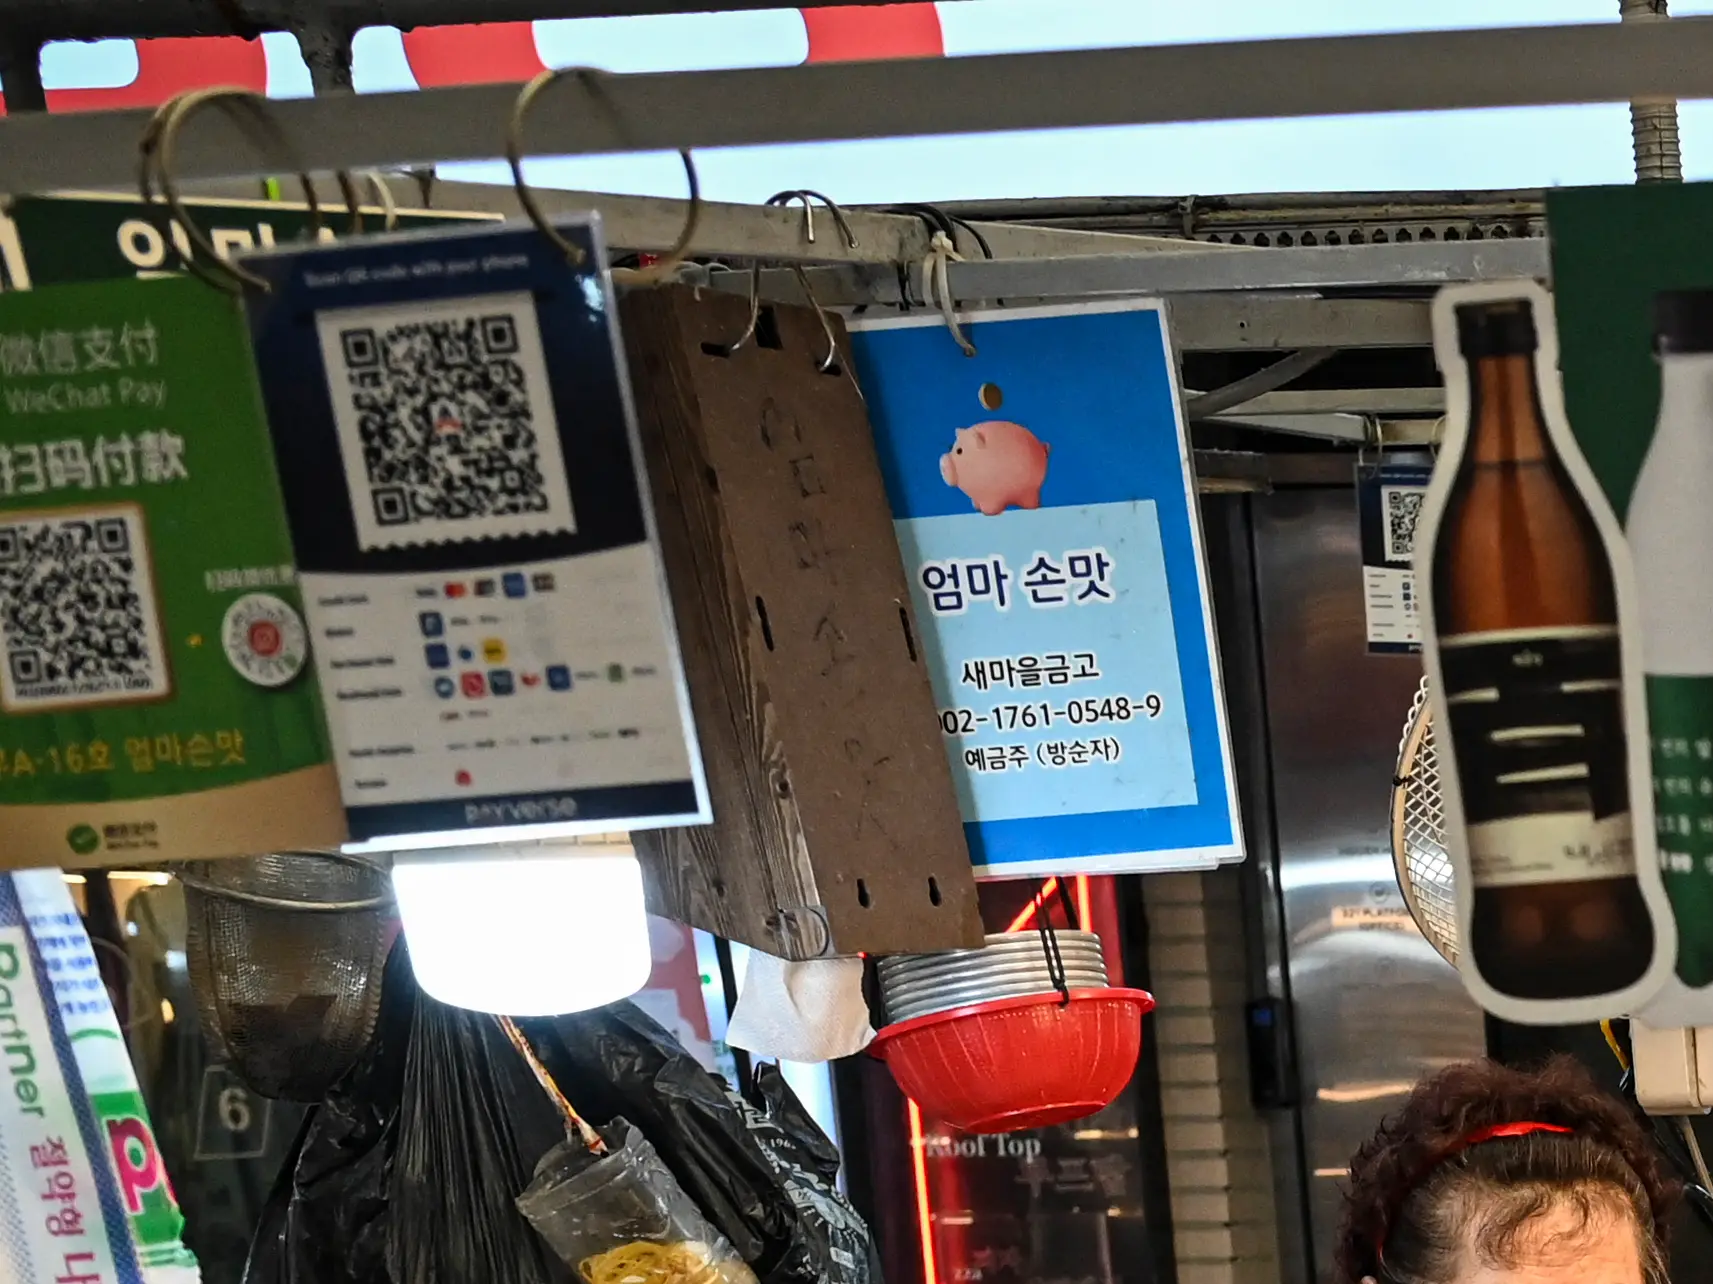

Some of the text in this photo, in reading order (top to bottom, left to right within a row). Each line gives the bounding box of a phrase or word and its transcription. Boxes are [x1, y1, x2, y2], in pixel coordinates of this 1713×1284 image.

[923, 552, 1111, 612] 엄마 손맛
[962, 653, 1100, 692] 새마을금고
[124, 727, 247, 774] 엄마손맛
[965, 735, 1121, 771] 예금주 (방순자)
